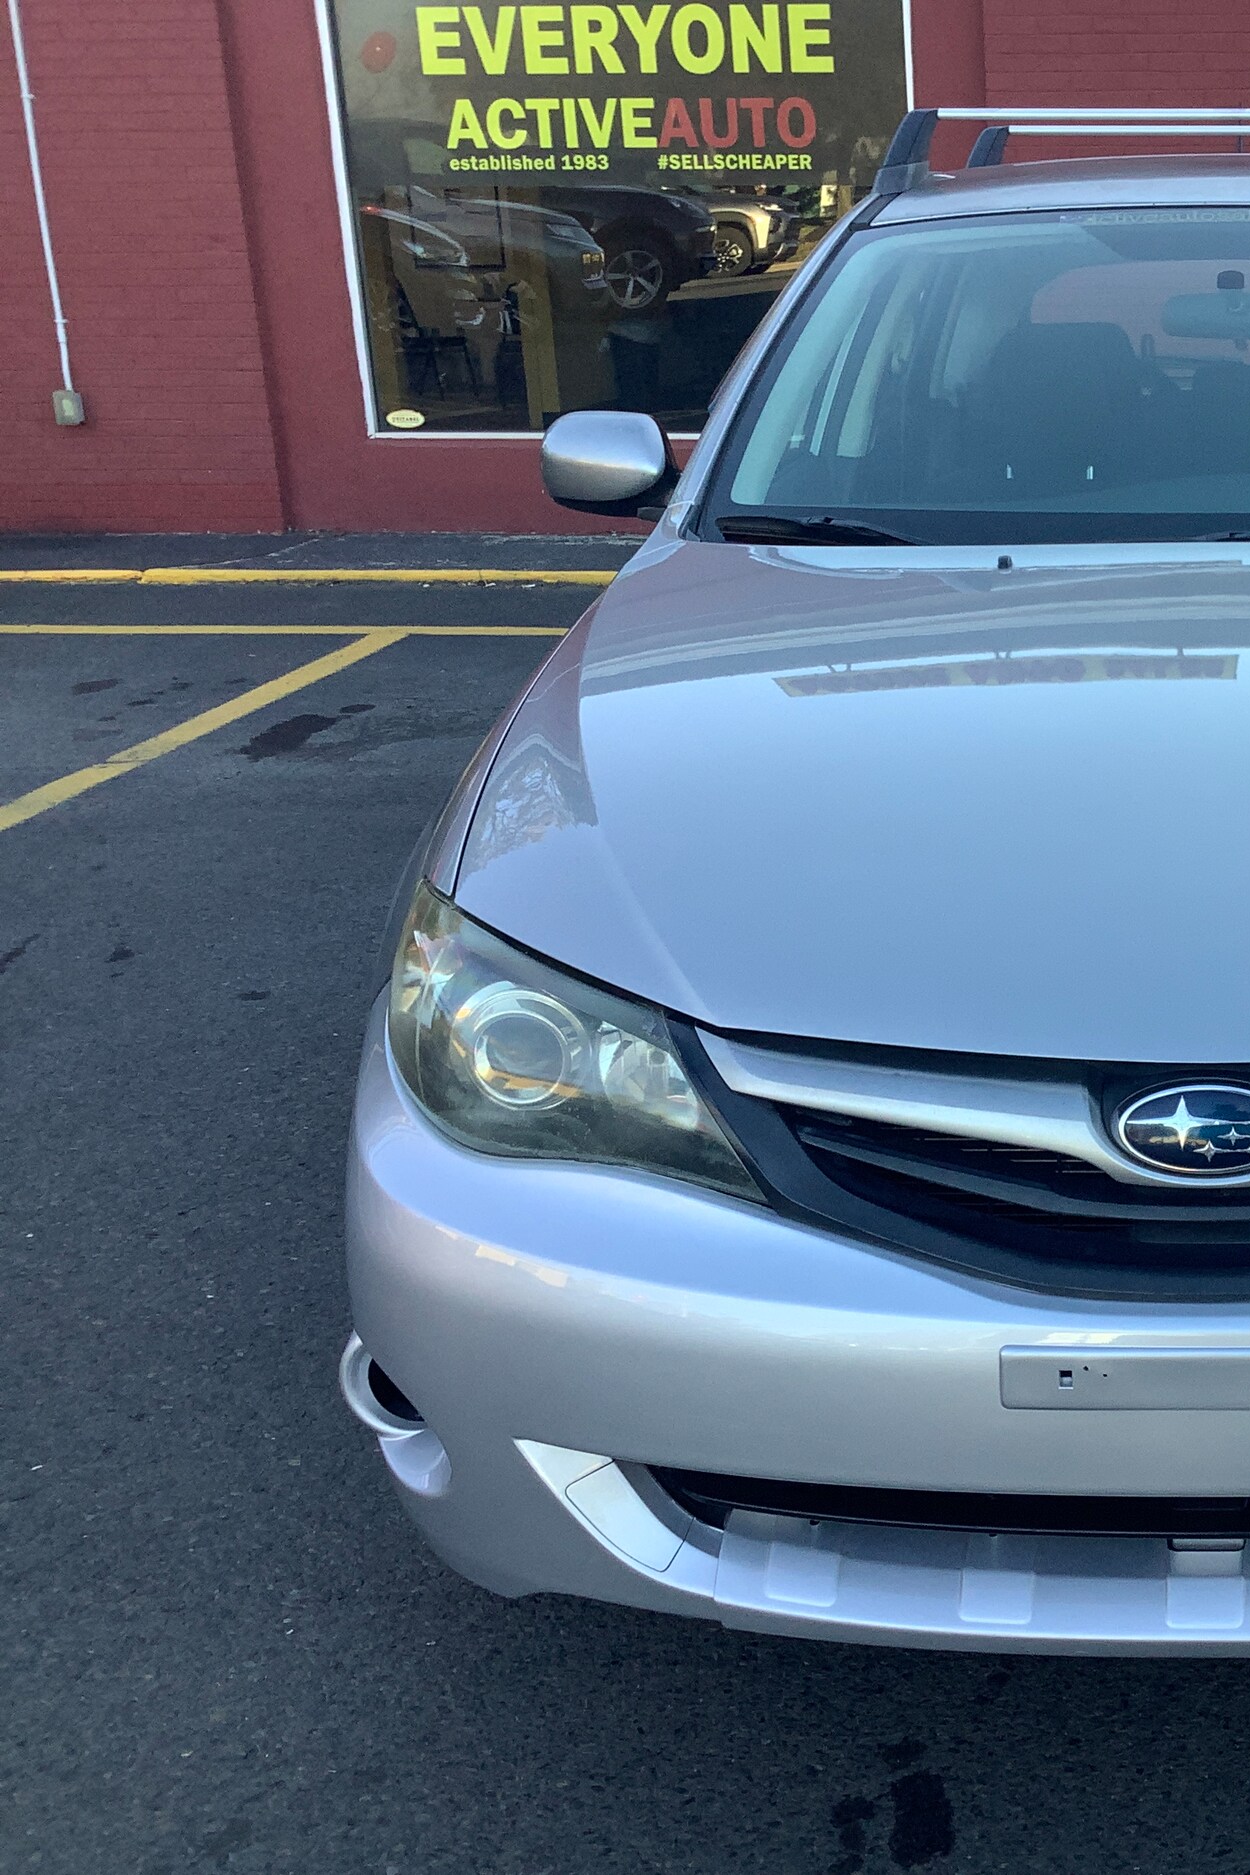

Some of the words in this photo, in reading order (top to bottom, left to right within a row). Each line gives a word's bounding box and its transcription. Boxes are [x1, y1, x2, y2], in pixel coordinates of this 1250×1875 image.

[415, 3, 835, 75] EVERYONE
[446, 97, 818, 150] ACTIVEAUTO
[449, 155, 556, 171] established
[561, 154, 609, 171] 1983
[657, 153, 812, 171] #SELLSCHEAPER
